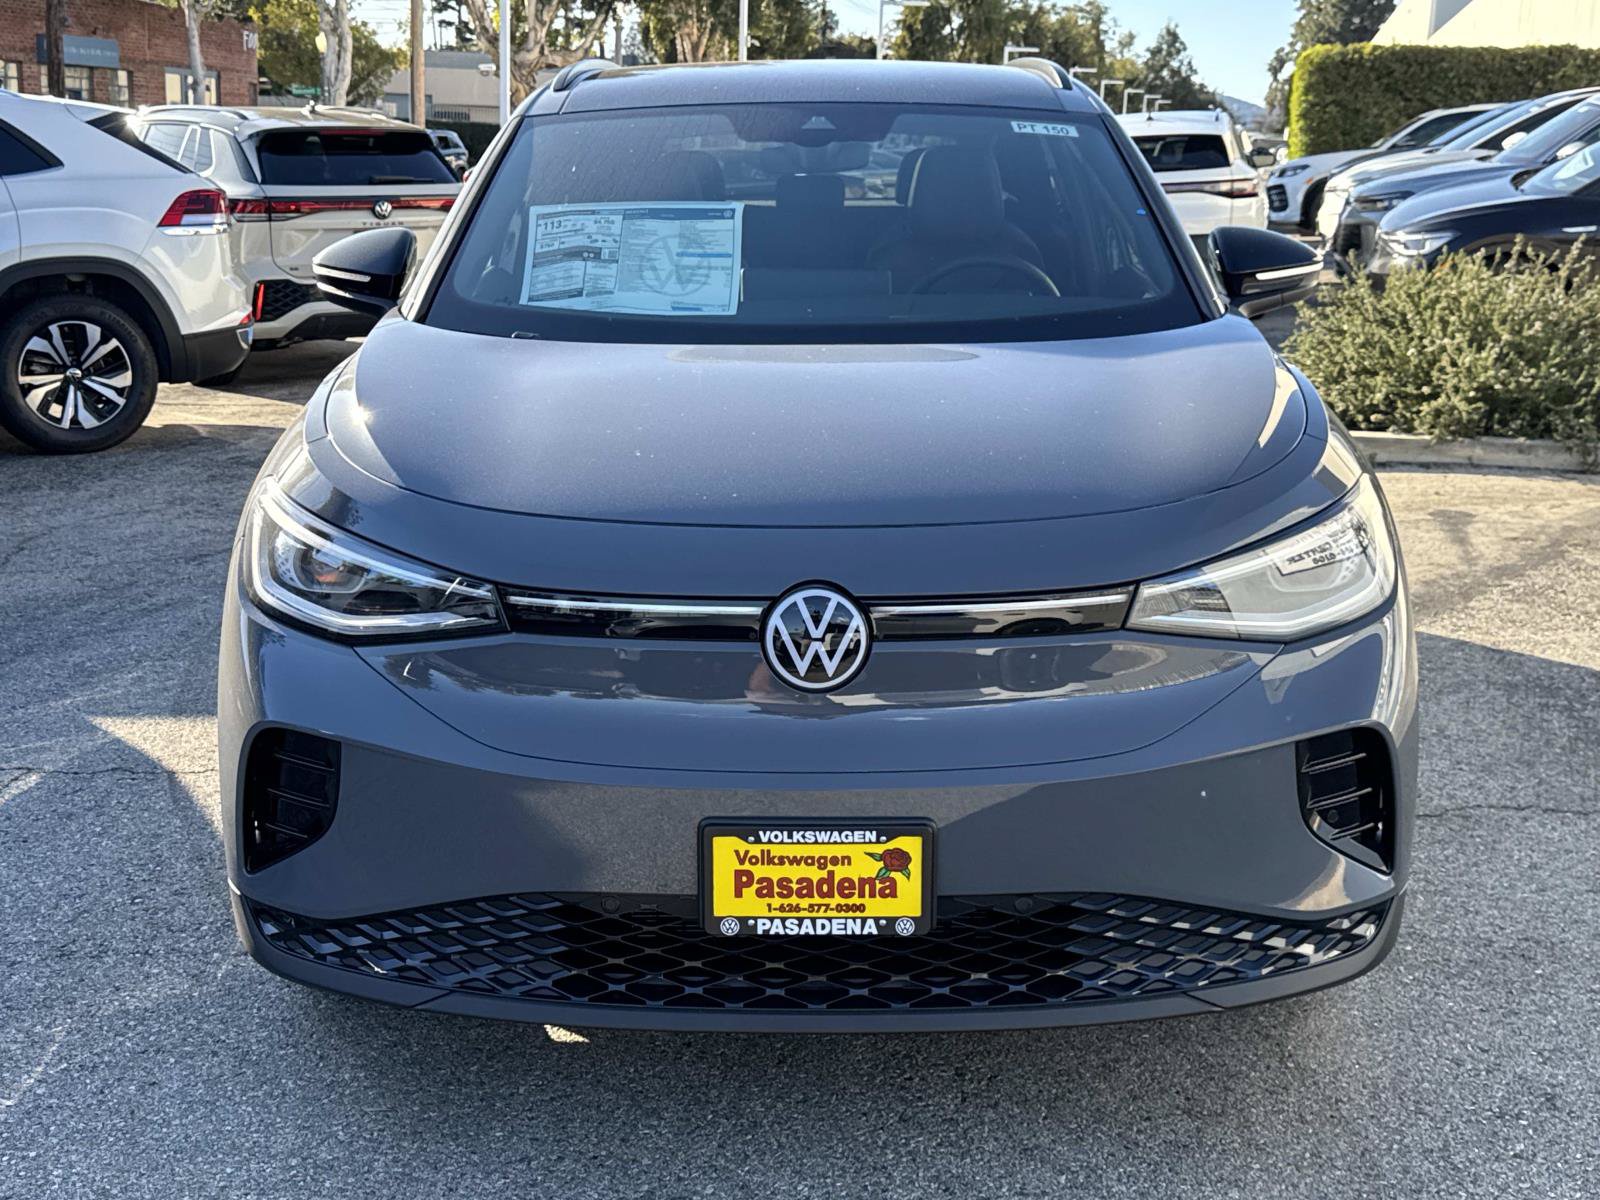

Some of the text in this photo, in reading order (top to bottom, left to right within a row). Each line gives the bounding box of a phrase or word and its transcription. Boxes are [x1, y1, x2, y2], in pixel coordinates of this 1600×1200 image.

[1016, 123, 1069, 135] PT 150
[543, 220, 563, 232] 113
[766, 589, 867, 689] VW
[758, 830, 877, 843] VOLKSWAGEN
[733, 849, 852, 870] Volkswagen
[733, 869, 898, 899] Pasadena
[766, 903, 866, 913] 1-626-577-0300
[720, 917, 740, 936] VW
[756, 918, 878, 935] PASADENA
[895, 917, 915, 936] VW
